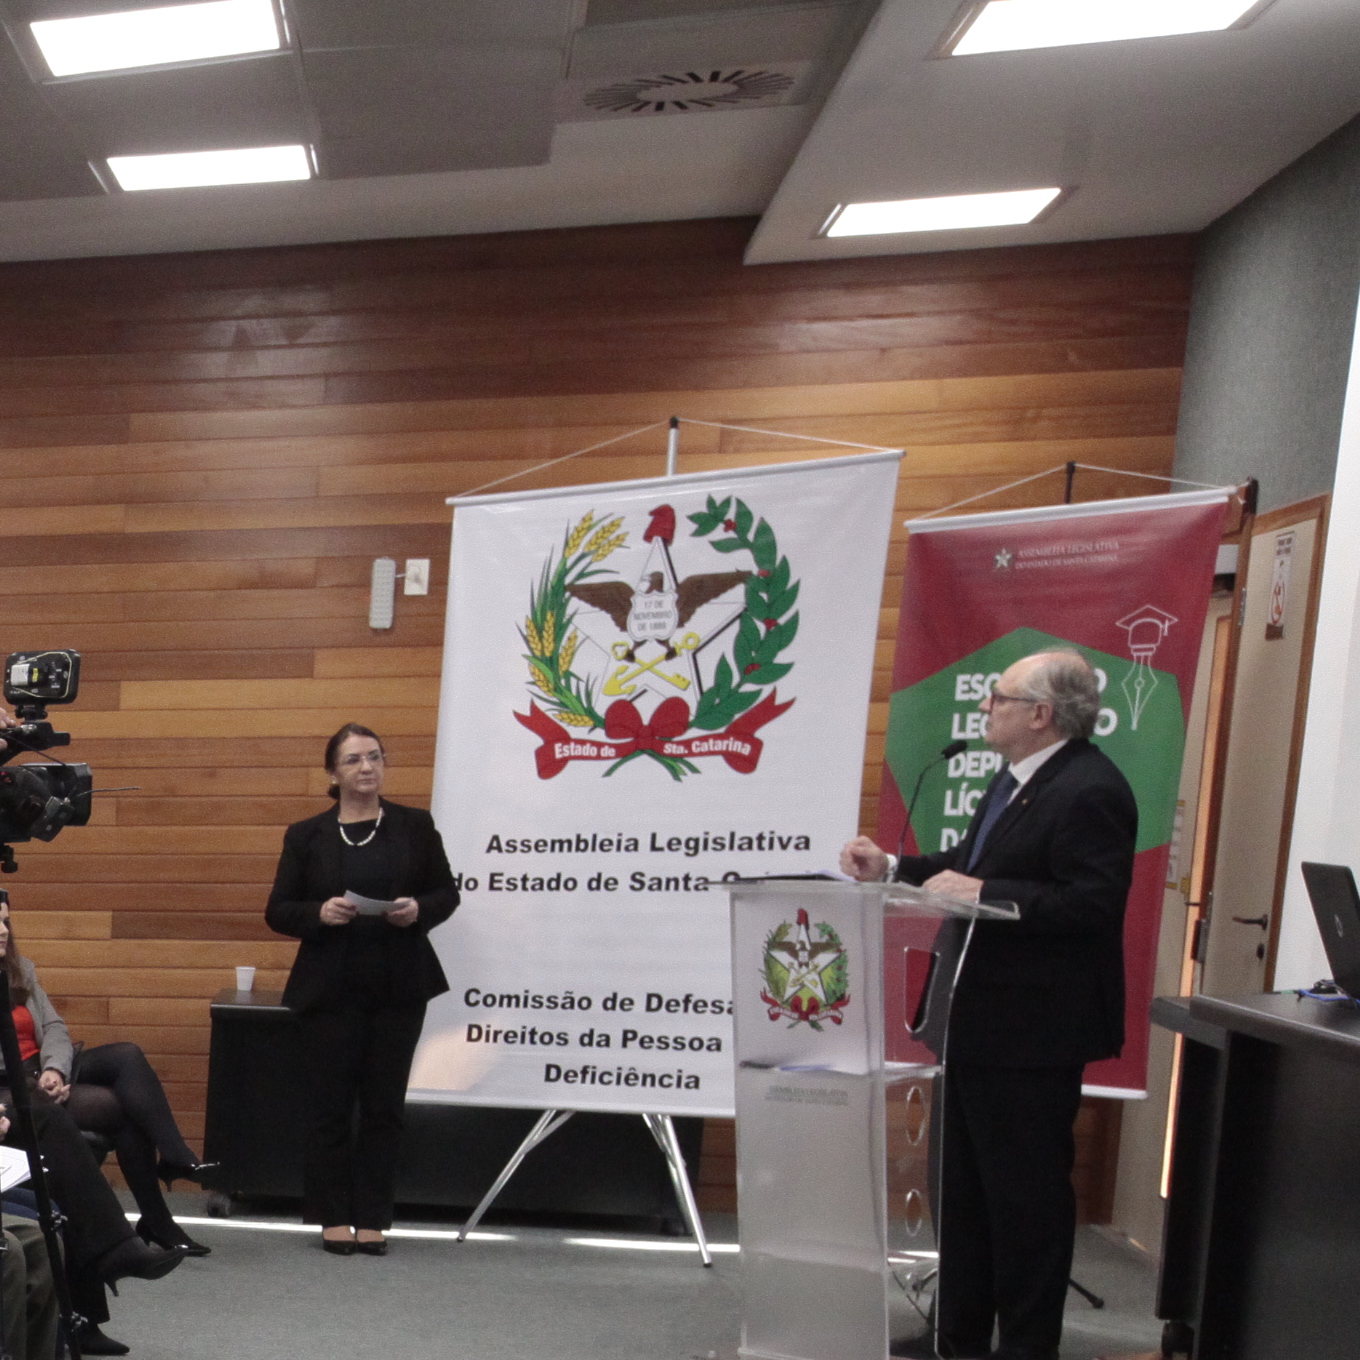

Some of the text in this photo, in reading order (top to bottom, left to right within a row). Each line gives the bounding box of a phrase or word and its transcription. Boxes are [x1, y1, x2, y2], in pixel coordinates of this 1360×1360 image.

[554, 737, 752, 759] Estado de Sta. Catarina
[486, 831, 811, 857] Assembleia Legislativa
[488, 872, 579, 892] Estado
[587, 871, 619, 892] de
[629, 871, 710, 892] Santa
[464, 988, 592, 1011] Comissão
[602, 992, 634, 1012] de
[466, 1023, 723, 1052] Direitos da Pessoa
[544, 1063, 701, 1090] Deficiência
